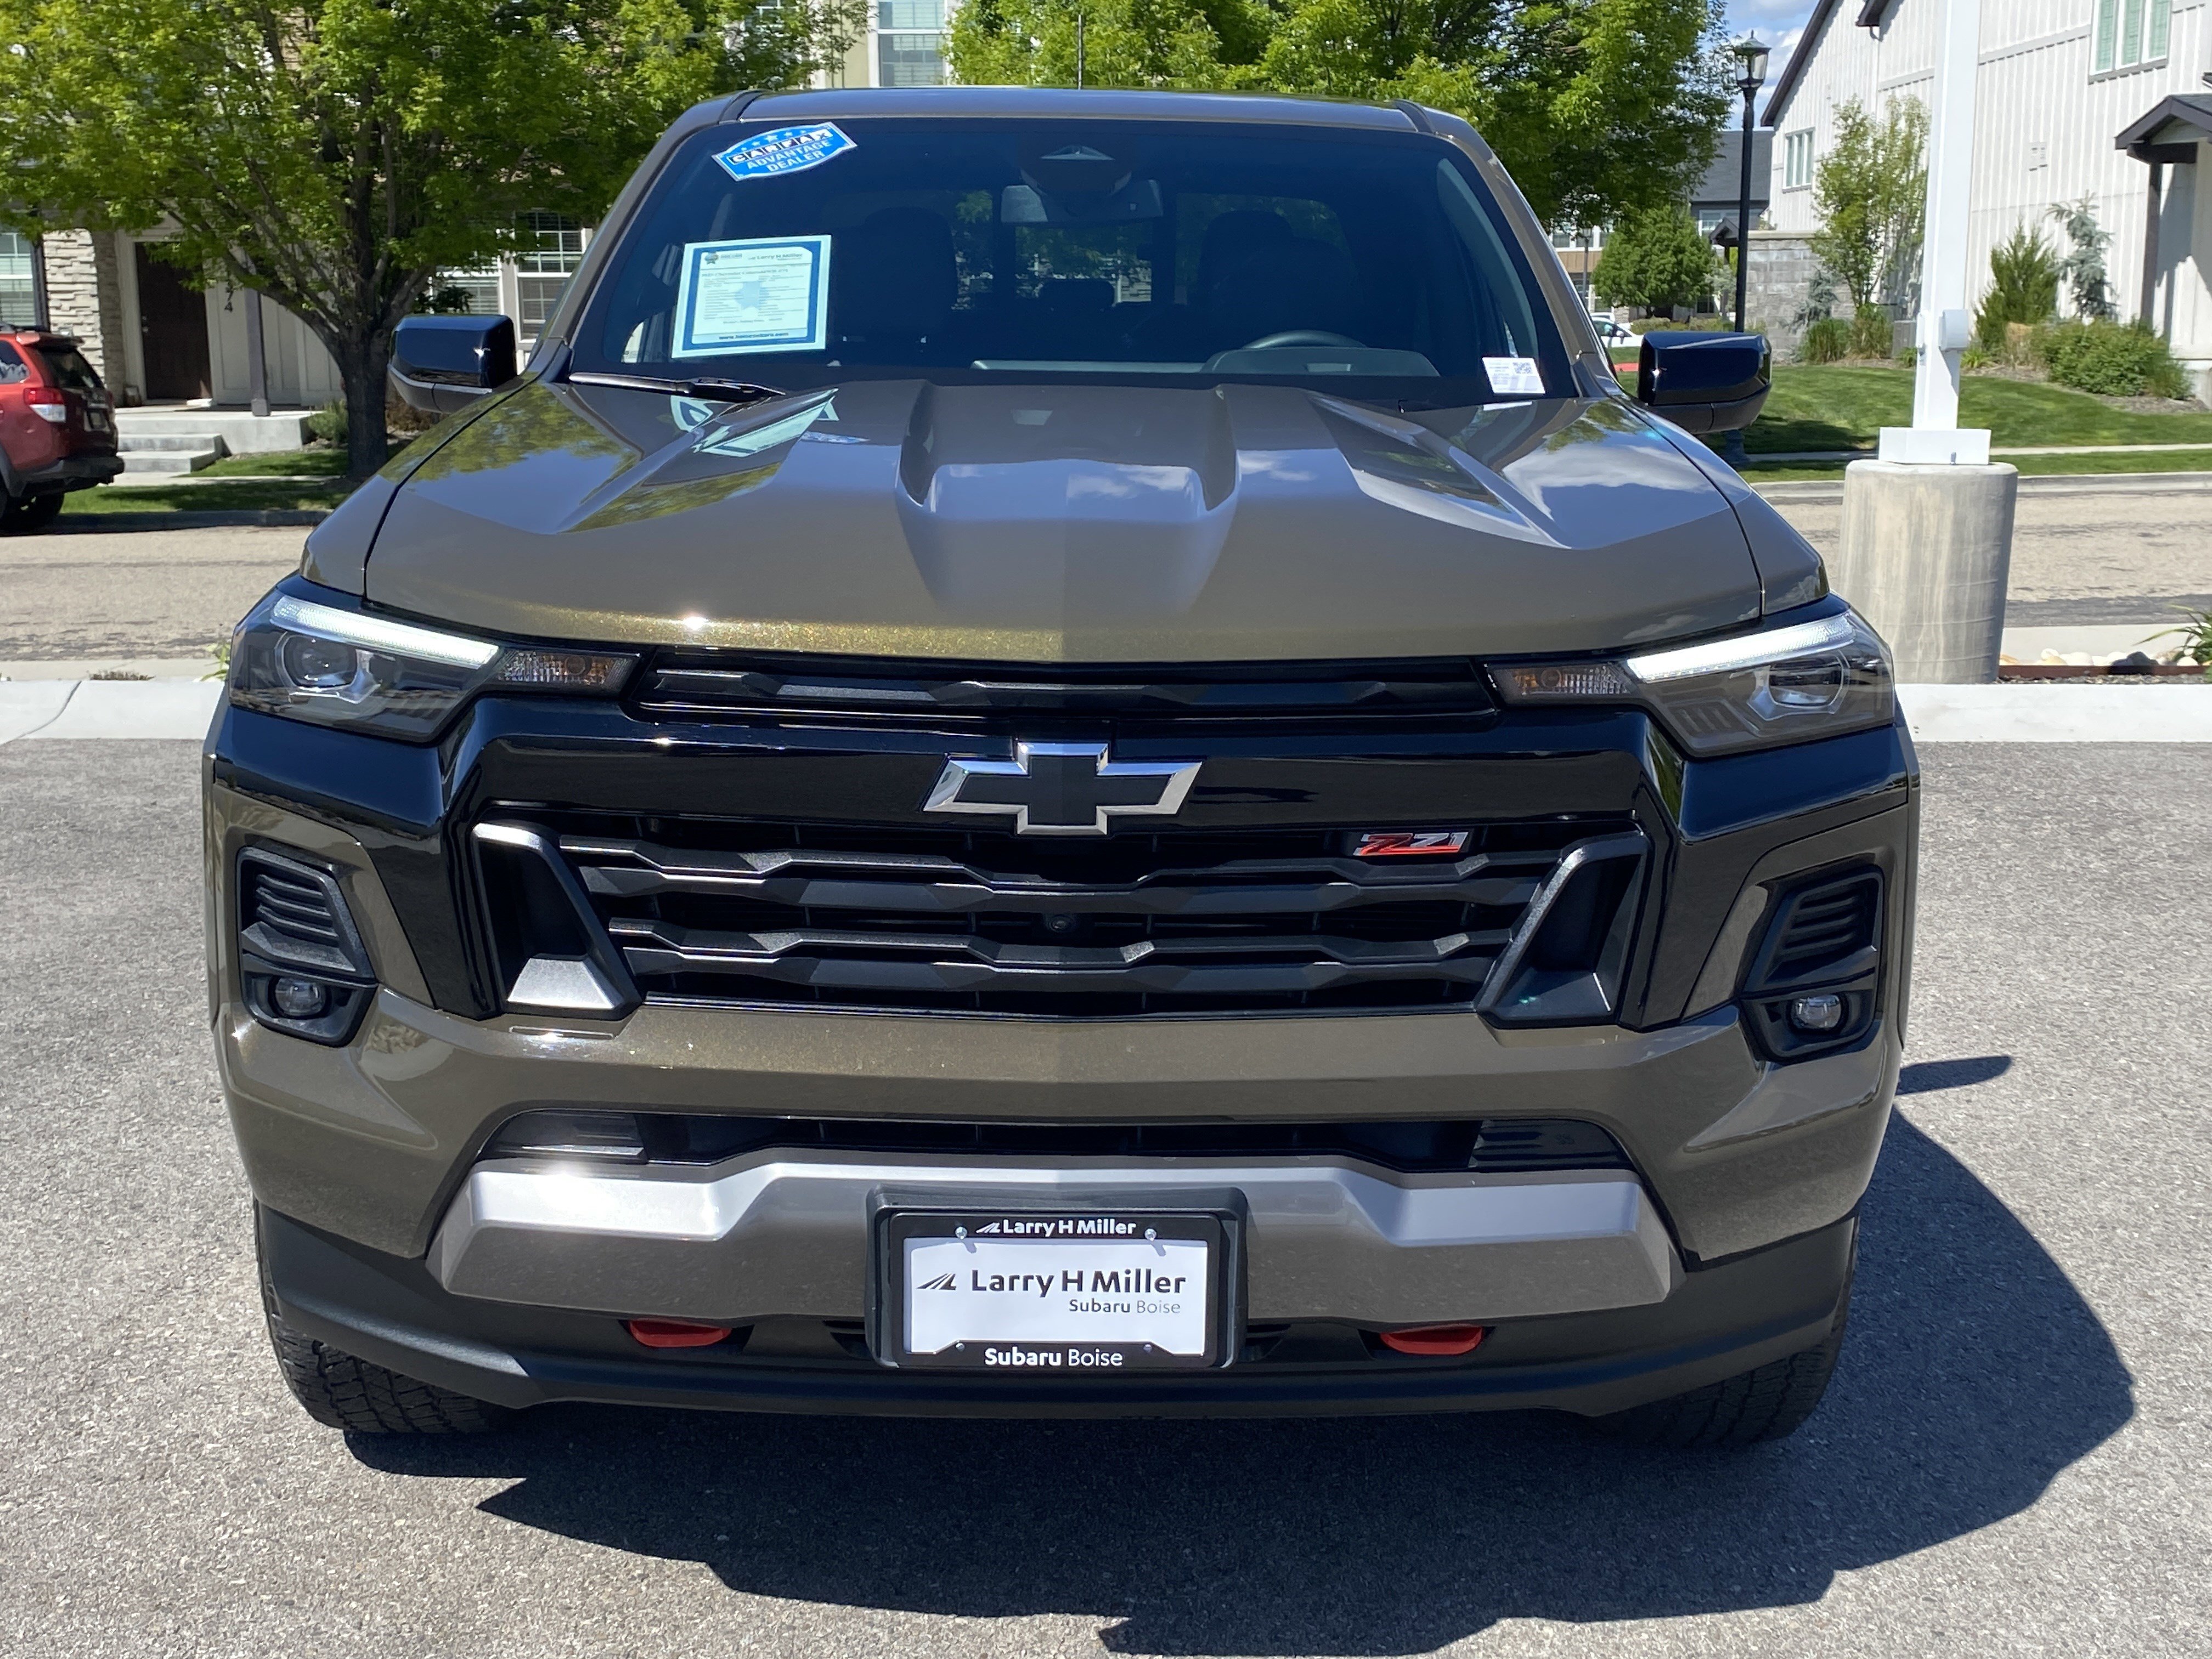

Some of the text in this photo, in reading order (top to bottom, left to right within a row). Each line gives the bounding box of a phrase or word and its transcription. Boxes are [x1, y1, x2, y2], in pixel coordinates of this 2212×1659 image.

[730, 129, 831, 163] CARFAX
[747, 139, 832, 169] ADVANTAGE
[766, 150, 826, 172] DEALER
[1353, 832, 1469, 856] Z71
[1002, 1218, 1136, 1237] Larry H Miller
[972, 1268, 1187, 1298] Larry H Miller
[1069, 1299, 1181, 1314] Subaru Boise
[984, 1346, 1123, 1366] Subaru Boise
